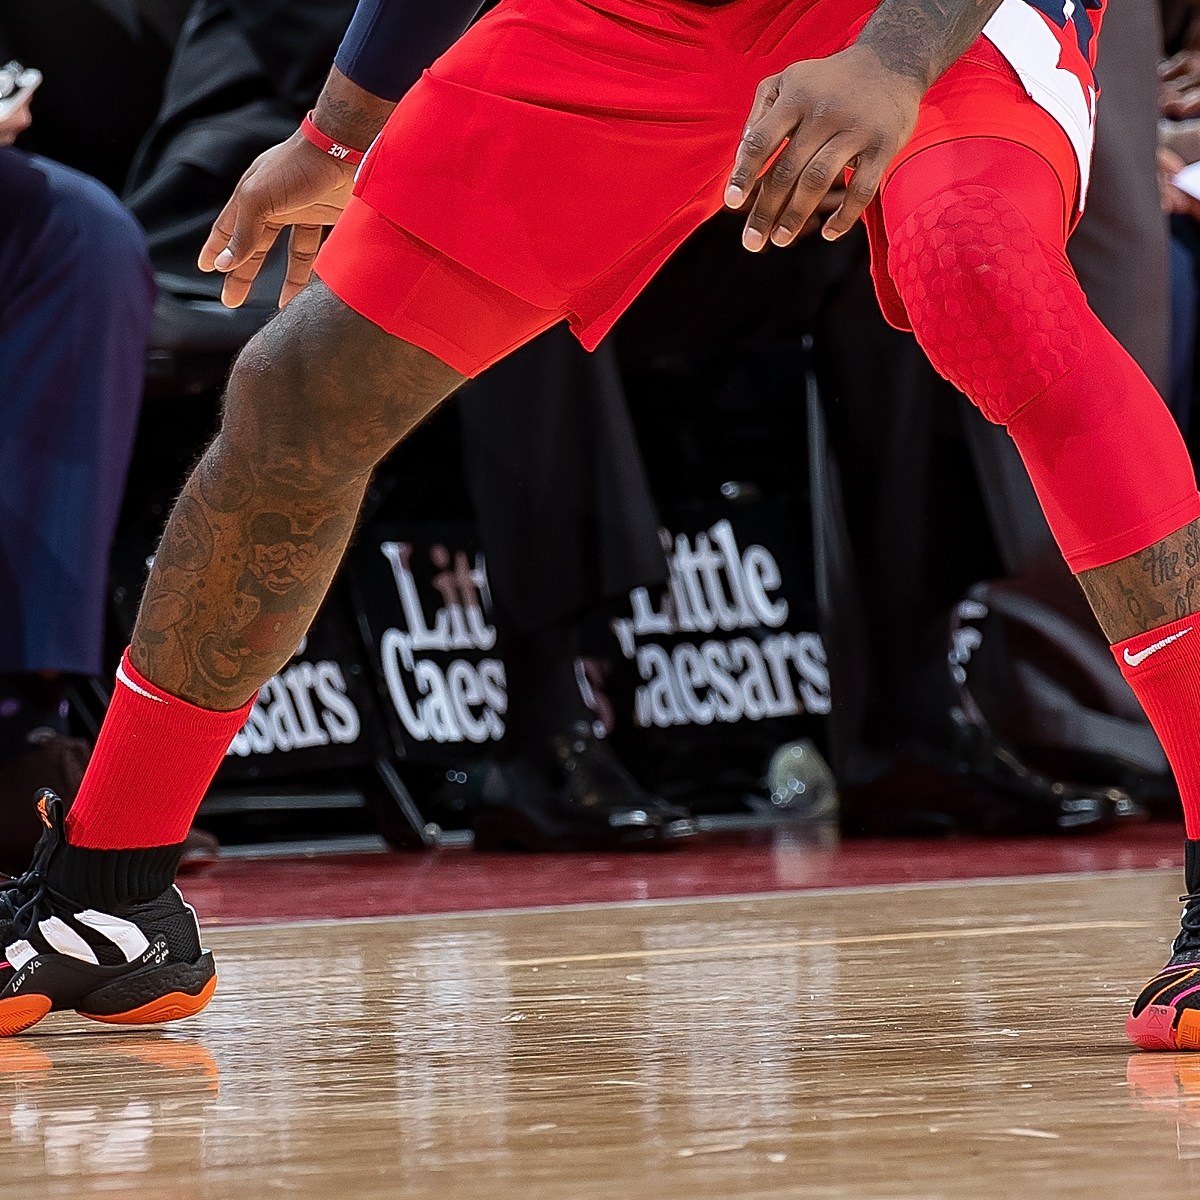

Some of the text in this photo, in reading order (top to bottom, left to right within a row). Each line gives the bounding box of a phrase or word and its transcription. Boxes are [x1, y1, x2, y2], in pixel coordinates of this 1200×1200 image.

[327, 143, 350, 159] ACE
[380, 541, 497, 650] Lit
[381, 628, 508, 743] Caes
[612, 618, 832, 728] aesars
[12, 960, 42, 992] Luv Ya
